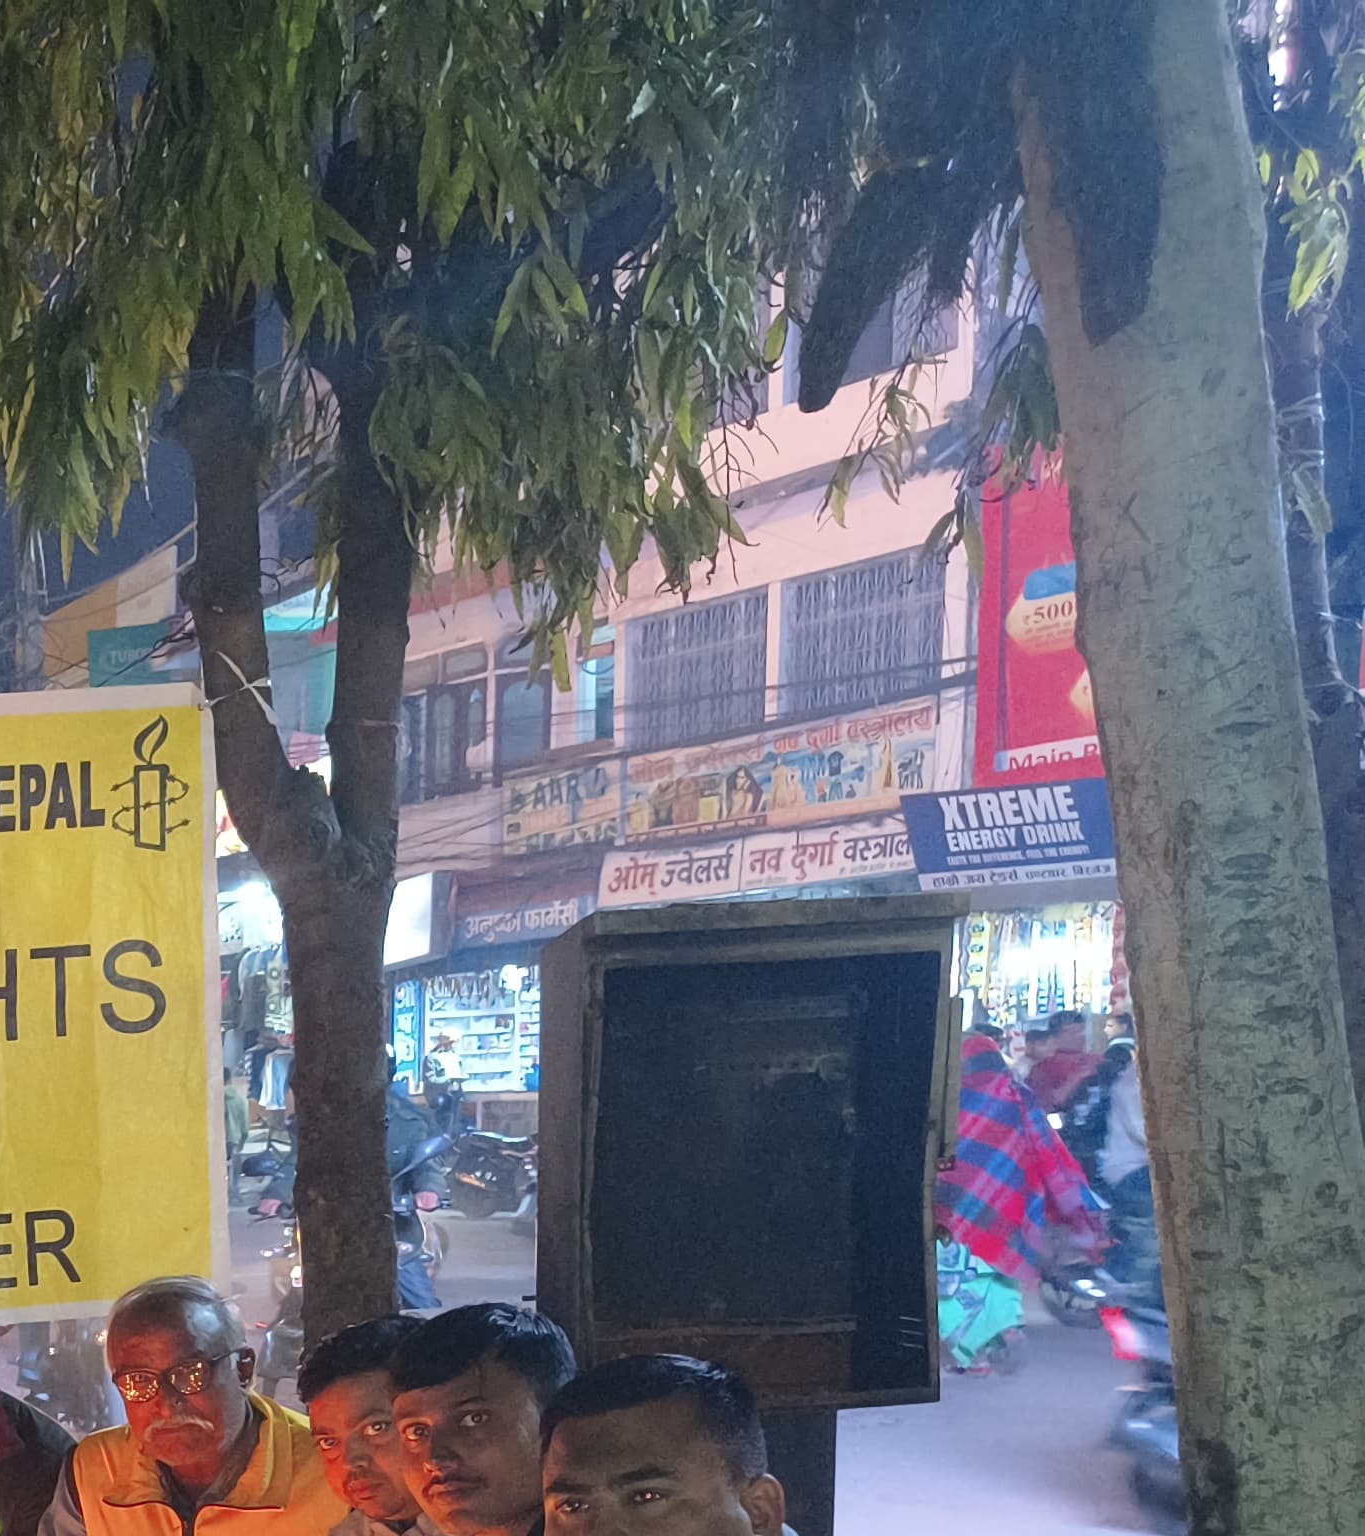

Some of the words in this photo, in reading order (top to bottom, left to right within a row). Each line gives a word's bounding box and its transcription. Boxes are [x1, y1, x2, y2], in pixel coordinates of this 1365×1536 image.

[938, 785, 1079, 831] XTREME
[749, 846, 785, 875] नव
[790, 830, 840, 881] दुर्गा
[946, 826, 1018, 853] ENERGY
[1022, 820, 1085, 846] DRINK
[661, 842, 736, 888] ज्वेलर्स
